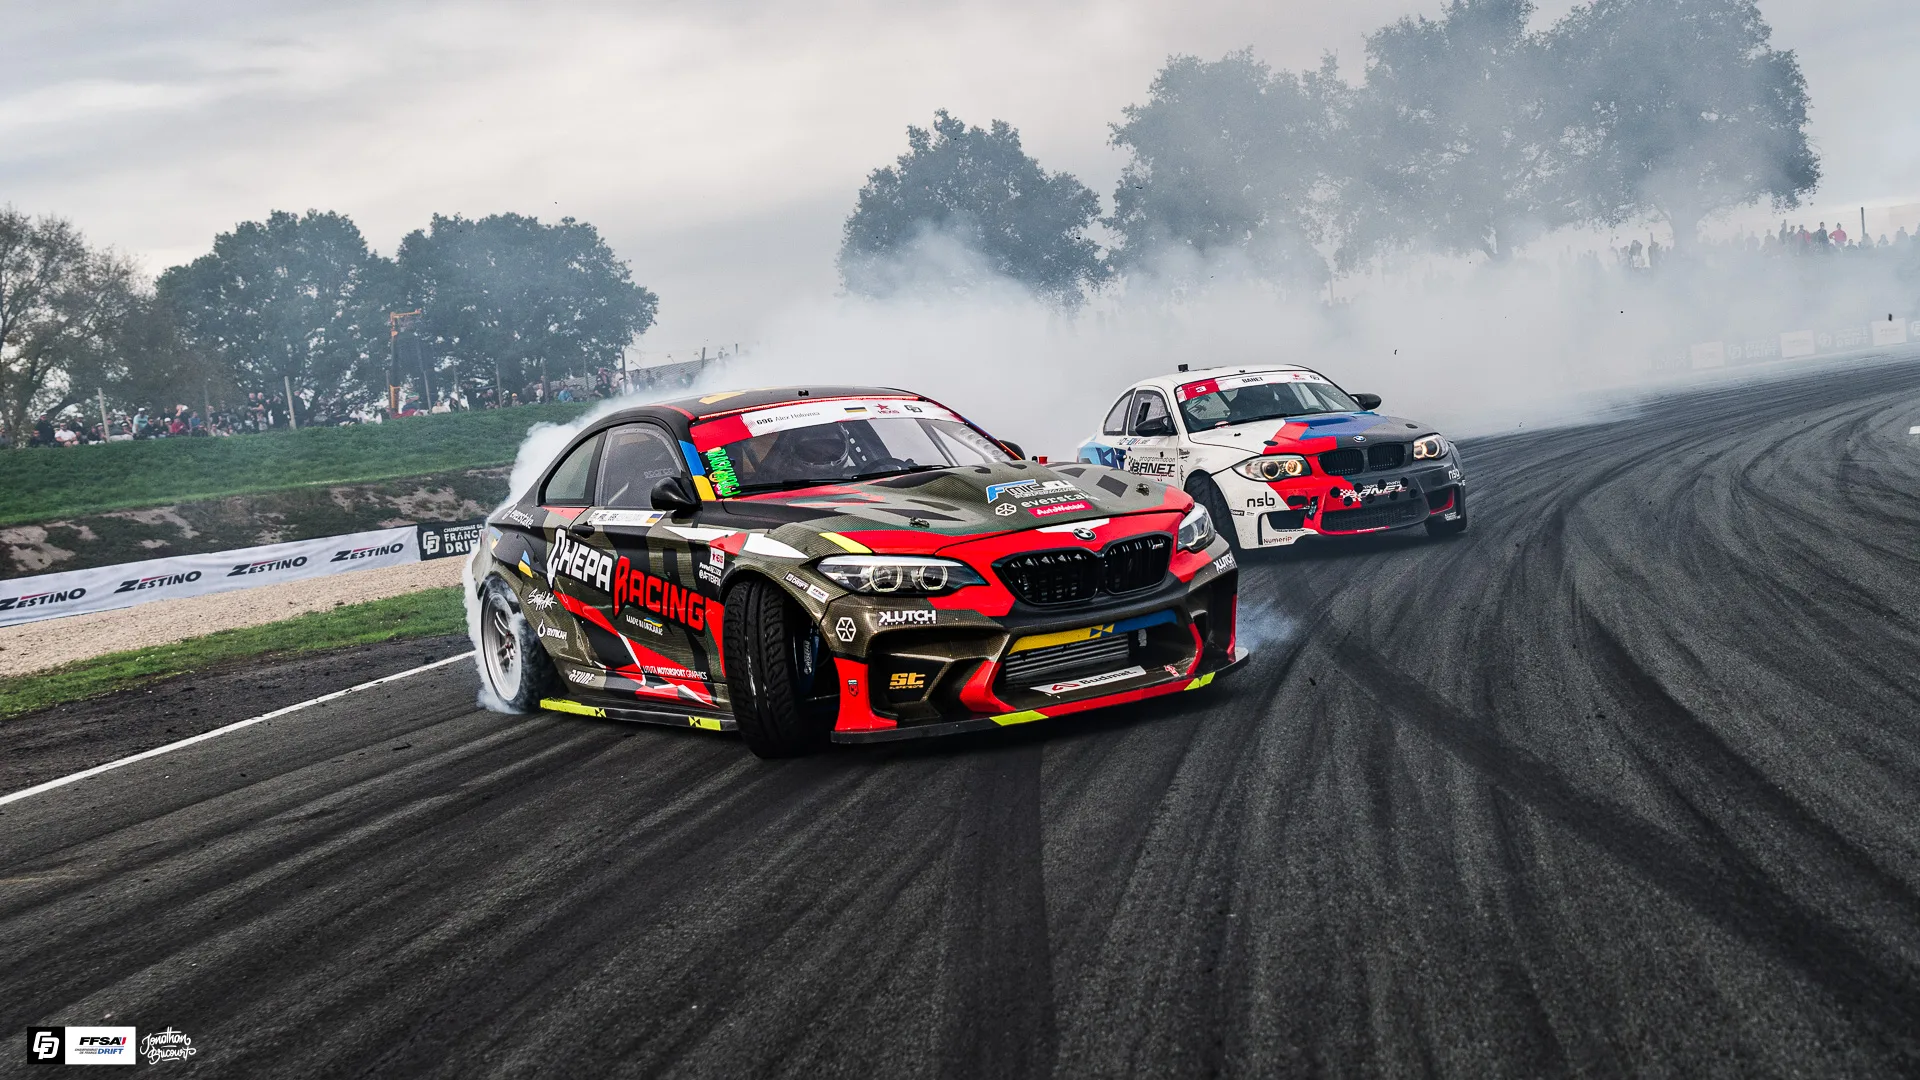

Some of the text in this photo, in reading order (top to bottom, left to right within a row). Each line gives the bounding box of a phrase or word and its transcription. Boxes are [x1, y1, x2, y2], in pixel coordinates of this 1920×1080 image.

[756, 417, 773, 425] 696
[1132, 462, 1175, 475] BANET
[1247, 492, 1275, 508] nsb
[330, 543, 404, 562] ZESTINO
[227, 556, 308, 577] ZESTINO
[114, 570, 202, 593] ZESTINO
[0, 587, 86, 611] ZESTINO
[614, 555, 704, 631] RACING
[879, 610, 936, 622] KLUTCH
